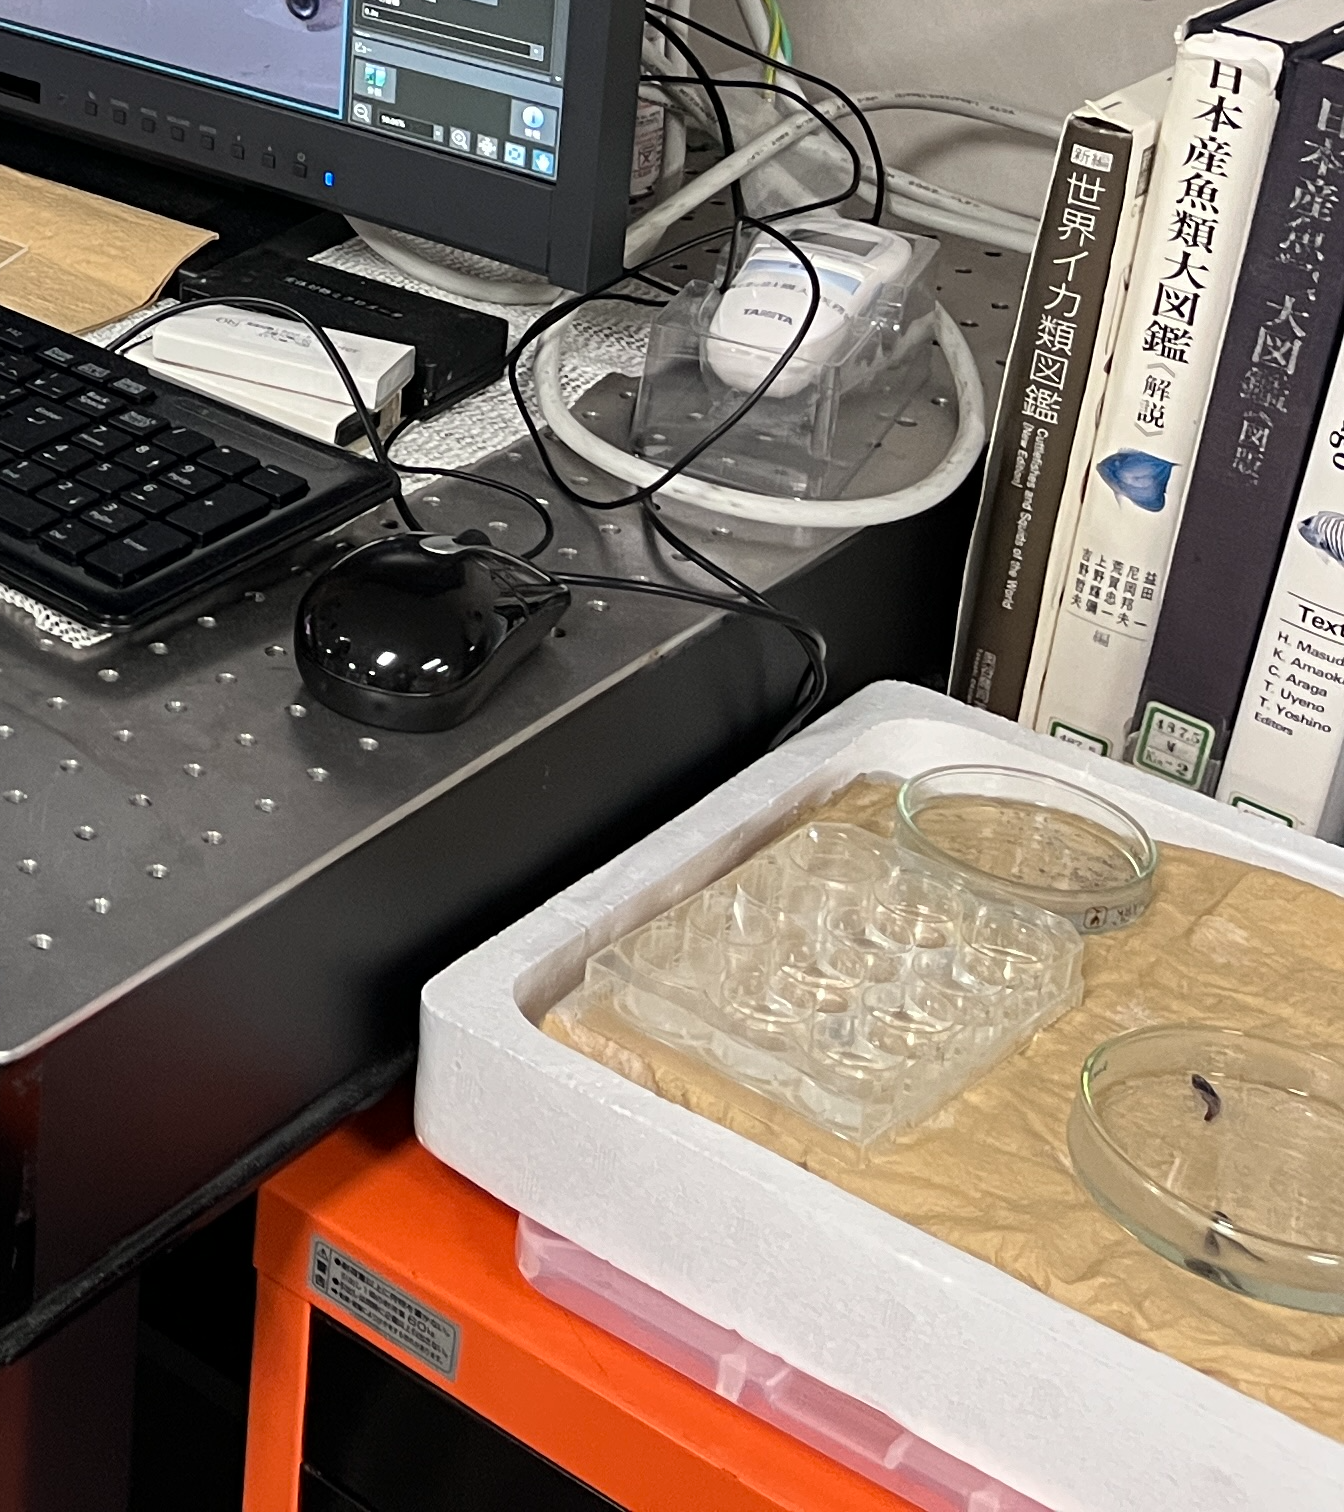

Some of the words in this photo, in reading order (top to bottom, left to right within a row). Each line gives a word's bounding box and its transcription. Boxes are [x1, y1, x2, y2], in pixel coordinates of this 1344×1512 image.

[1142, 59, 1243, 365] 日本産魚類大図鑑
[1021, 171, 1107, 425] 世界イカ類図鑑
[743, 308, 793, 326] TANITA
[1021, 489, 1034, 511] and
[1014, 511, 1032, 547] Squids
[1002, 578, 1018, 610] World
[1273, 647, 1286, 663] K.
[1277, 631, 1292, 647] H.
[1264, 679, 1275, 694] T.
[1280, 687, 1325, 714] Uyeno
[1268, 664, 1281, 679] C.
[1286, 673, 1328, 698] Araga
[1254, 711, 1294, 736] Editors
[1259, 695, 1271, 711] T.
[1276, 703, 1332, 734] Yoshino
